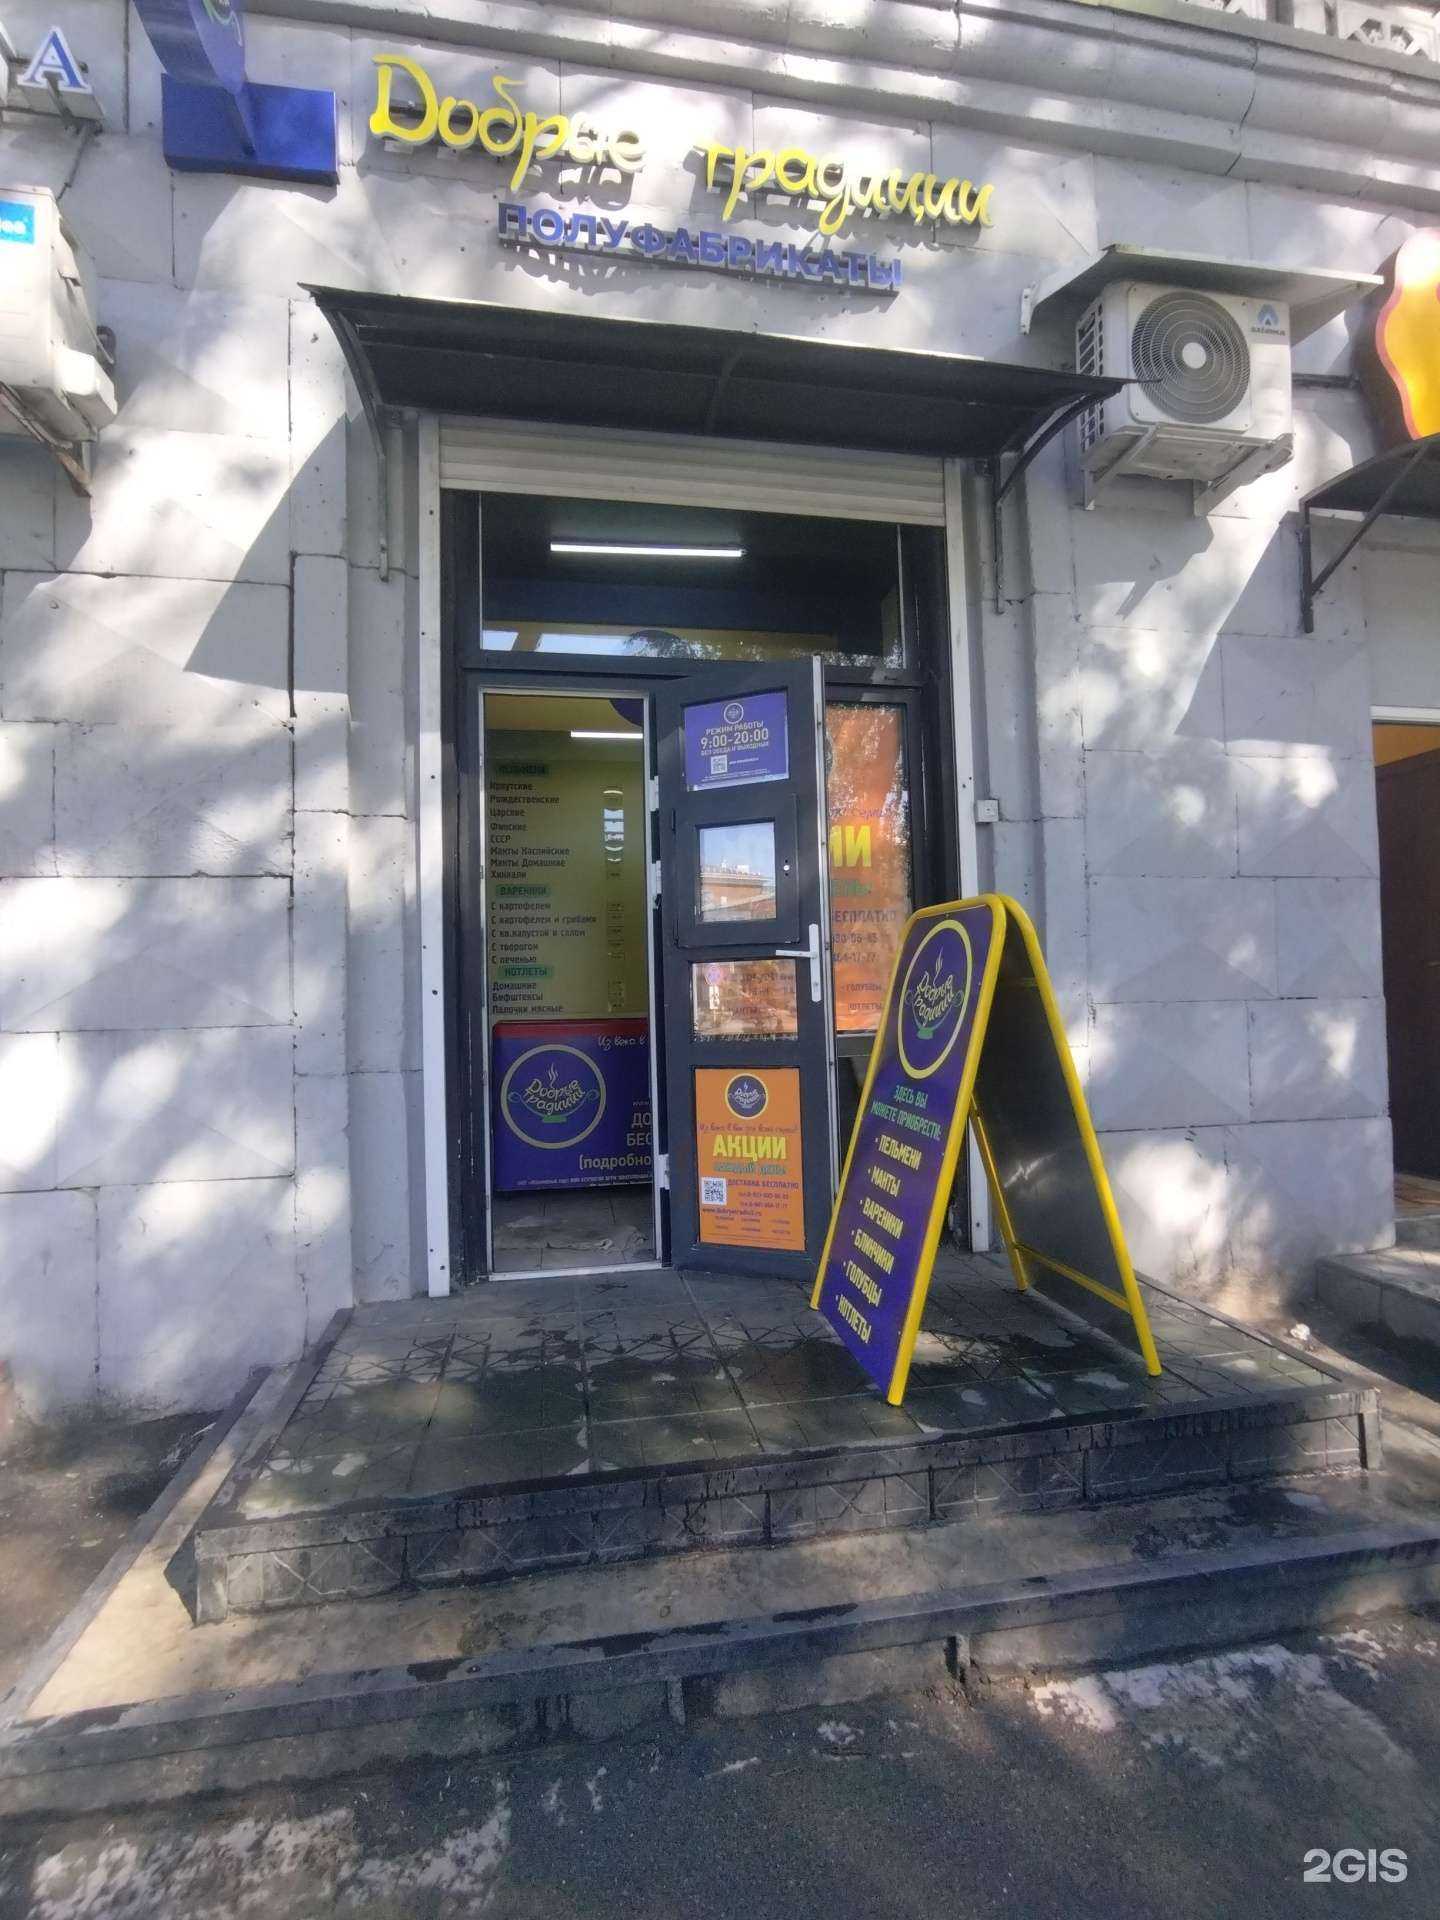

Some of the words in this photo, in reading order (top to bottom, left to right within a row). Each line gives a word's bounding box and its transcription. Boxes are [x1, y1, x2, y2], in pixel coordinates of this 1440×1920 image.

[371, 54, 646, 191] Добрые
[498, 203, 902, 288] ПОЛУФАБРИКАТЫ
[701, 728, 769, 750] 9:00-20:00
[706, 725, 733, 736] РЕЖИМ
[734, 720, 764, 731] РАБОТЫ
[490, 835, 511, 843] СССР
[831, 909, 897, 924] ЕСПЛАТНО
[870, 1100, 897, 1123] МОЖЕТЕ
[893, 1085, 914, 1104] ЗДЕСЬ
[914, 1091, 929, 1108] ВЫ
[713, 1134, 787, 1162] АКЦИИ
[878, 1134, 922, 1171] ПЕЛЬМЕНИ
[870, 1166, 902, 1197] МАНТЫ
[862, 1197, 904, 1239] ВАРЕНИКИ
[853, 1228, 895, 1275] БЛИНЧИКИ
[845, 1260, 883, 1307] ГОЛУБЦЫ
[837, 1294, 872, 1344] КОТЛЕТЫ
